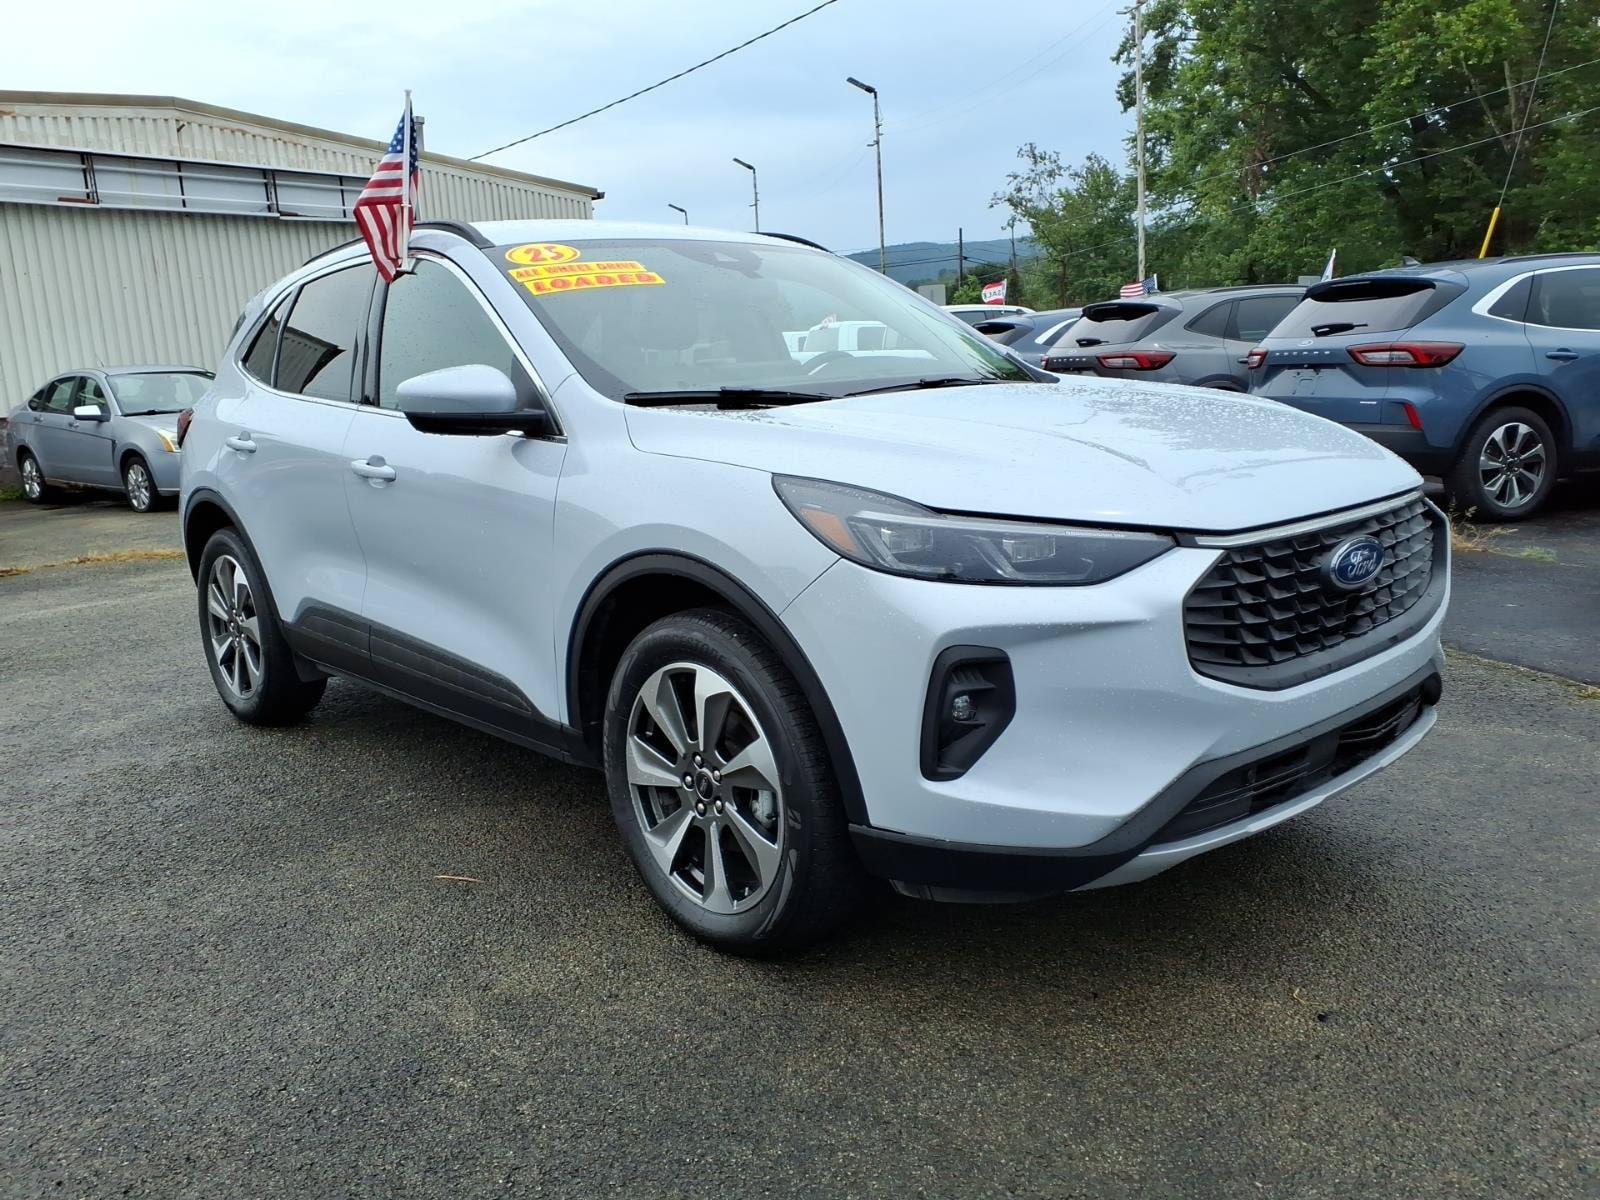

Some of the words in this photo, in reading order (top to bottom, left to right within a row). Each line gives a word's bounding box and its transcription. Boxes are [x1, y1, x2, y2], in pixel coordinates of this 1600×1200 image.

[524, 246, 564, 262] 25
[515, 268, 540, 279] ALL
[544, 263, 593, 274] WHEEL
[596, 262, 638, 271] DRIVE
[533, 272, 657, 293] LOADED
[1347, 548, 1377, 578] Ford
